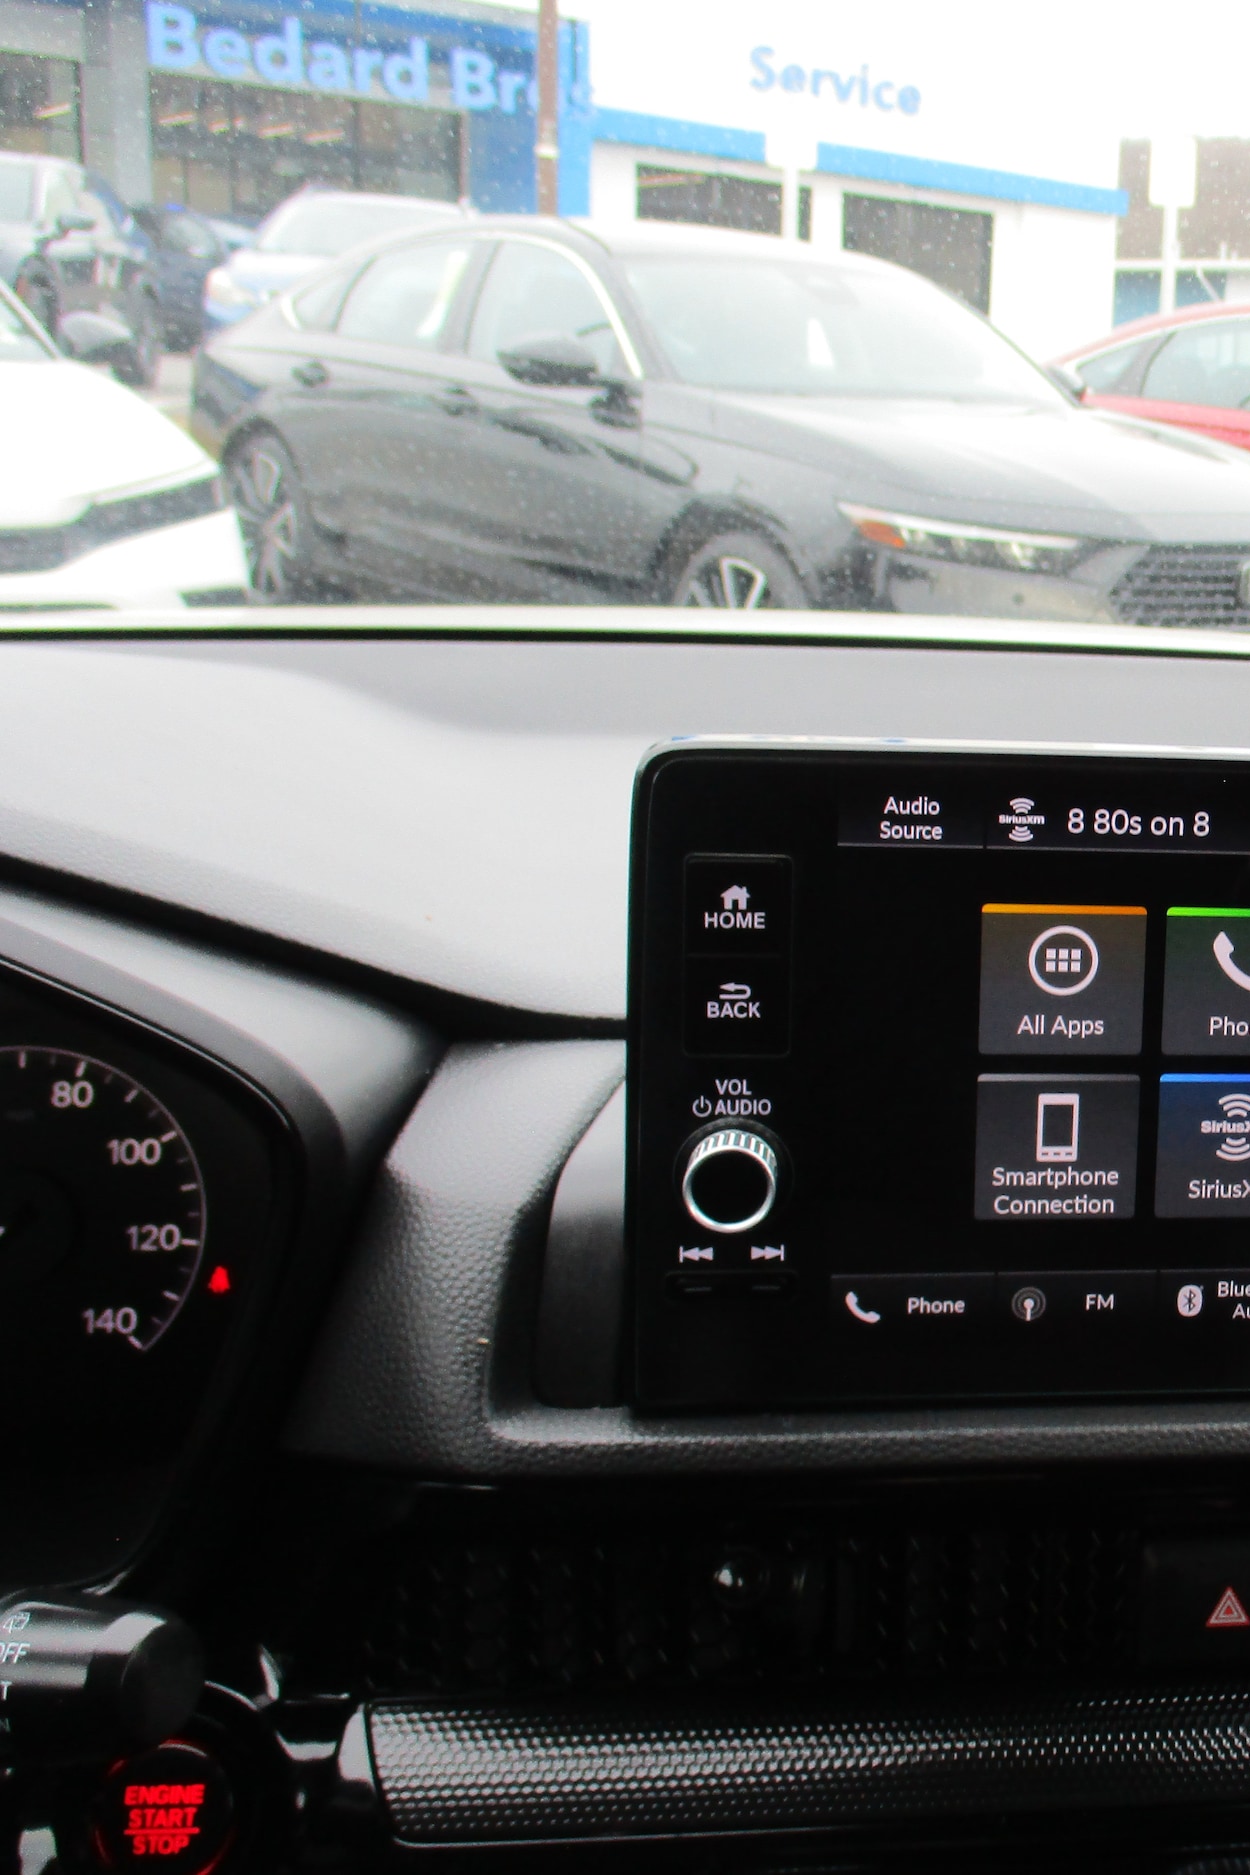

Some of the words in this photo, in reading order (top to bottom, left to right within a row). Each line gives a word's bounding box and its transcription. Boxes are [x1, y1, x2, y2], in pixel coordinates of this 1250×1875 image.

[146, 3, 429, 101] Bedard
[750, 45, 921, 115] Service
[883, 796, 941, 816] Audio
[879, 820, 943, 841] Source
[1067, 807, 1085, 834] 8
[1093, 808, 1142, 836] 80s
[1150, 816, 1184, 837] on
[1192, 811, 1210, 837] 8
[704, 911, 766, 930] HOME
[706, 1001, 761, 1019] BACK
[1017, 1014, 1045, 1035] All
[1050, 1015, 1105, 1039] Apps
[50, 1080, 94, 1108] 80
[715, 1078, 752, 1096] VOL
[714, 1098, 772, 1116] AUDIO
[108, 1138, 161, 1166] 100
[991, 1165, 1119, 1190] Smartphone
[993, 1193, 1115, 1215] Connection
[127, 1223, 181, 1252] 120
[907, 1296, 966, 1315] Phone
[1085, 1293, 1115, 1311] FM
[83, 1306, 138, 1335] 140
[124, 1783, 205, 1806] ENGINE
[129, 1806, 197, 1829] START
[133, 1834, 190, 1855] STOP
